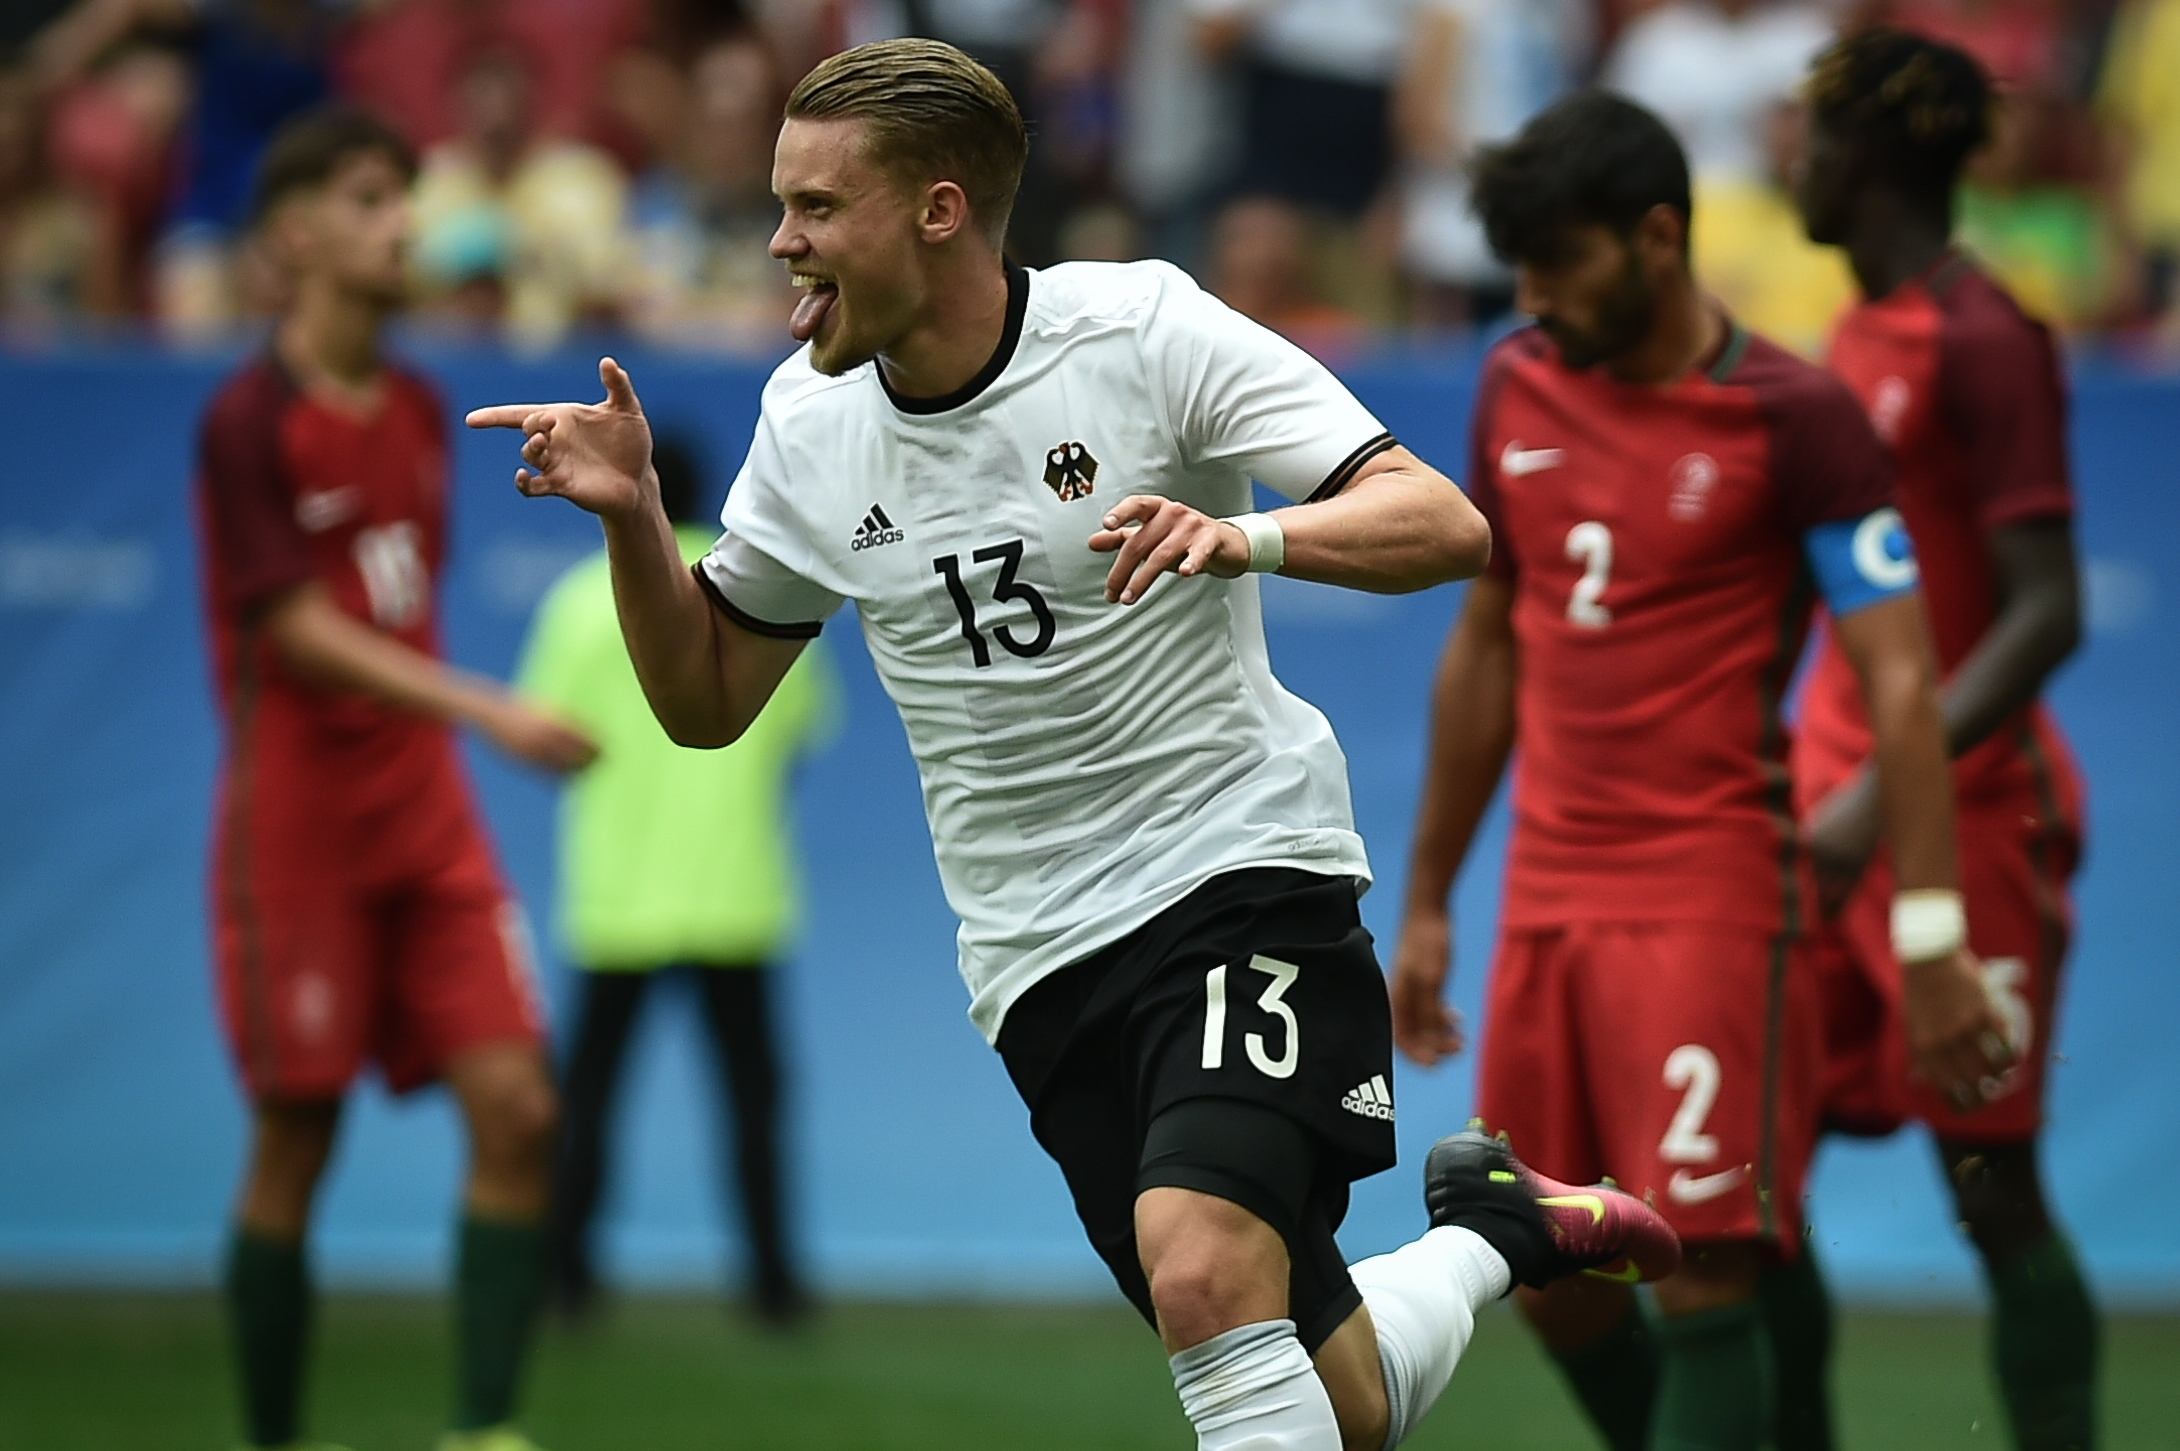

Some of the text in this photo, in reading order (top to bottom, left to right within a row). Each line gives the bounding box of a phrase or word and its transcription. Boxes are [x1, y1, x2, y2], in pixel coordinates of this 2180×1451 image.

[851, 529, 904, 552] adidas
[1564, 520, 1613, 629] 2
[933, 538, 1056, 668] 13
[1202, 953, 1300, 1080] 13
[1659, 1043, 1722, 1163] 2
